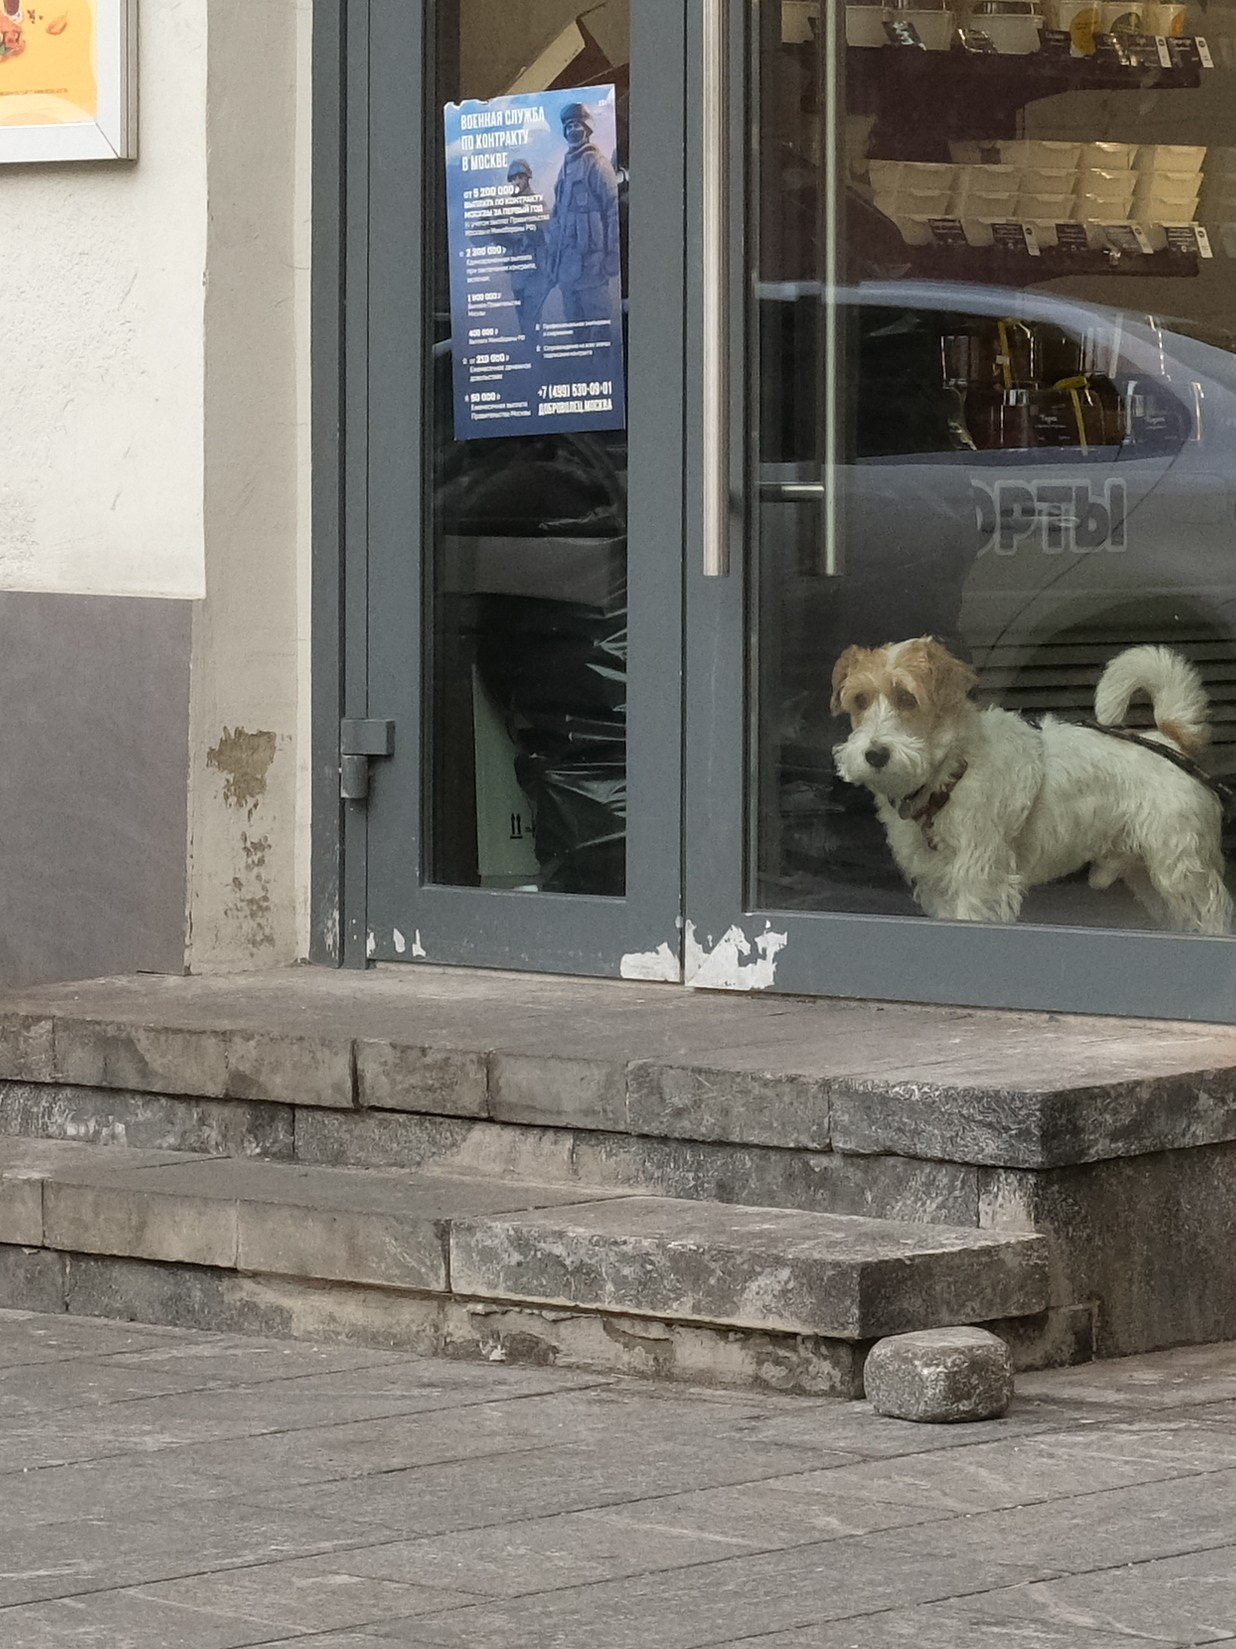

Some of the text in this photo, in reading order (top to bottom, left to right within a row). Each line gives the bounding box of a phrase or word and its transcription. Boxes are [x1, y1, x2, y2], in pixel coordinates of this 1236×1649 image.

[461, 106, 545, 130] ВОЕННАЯ СЛУЖБА
[461, 129, 529, 150] ПО КОНТРАКТУ
[462, 152, 508, 171] В МОСКВЕ
